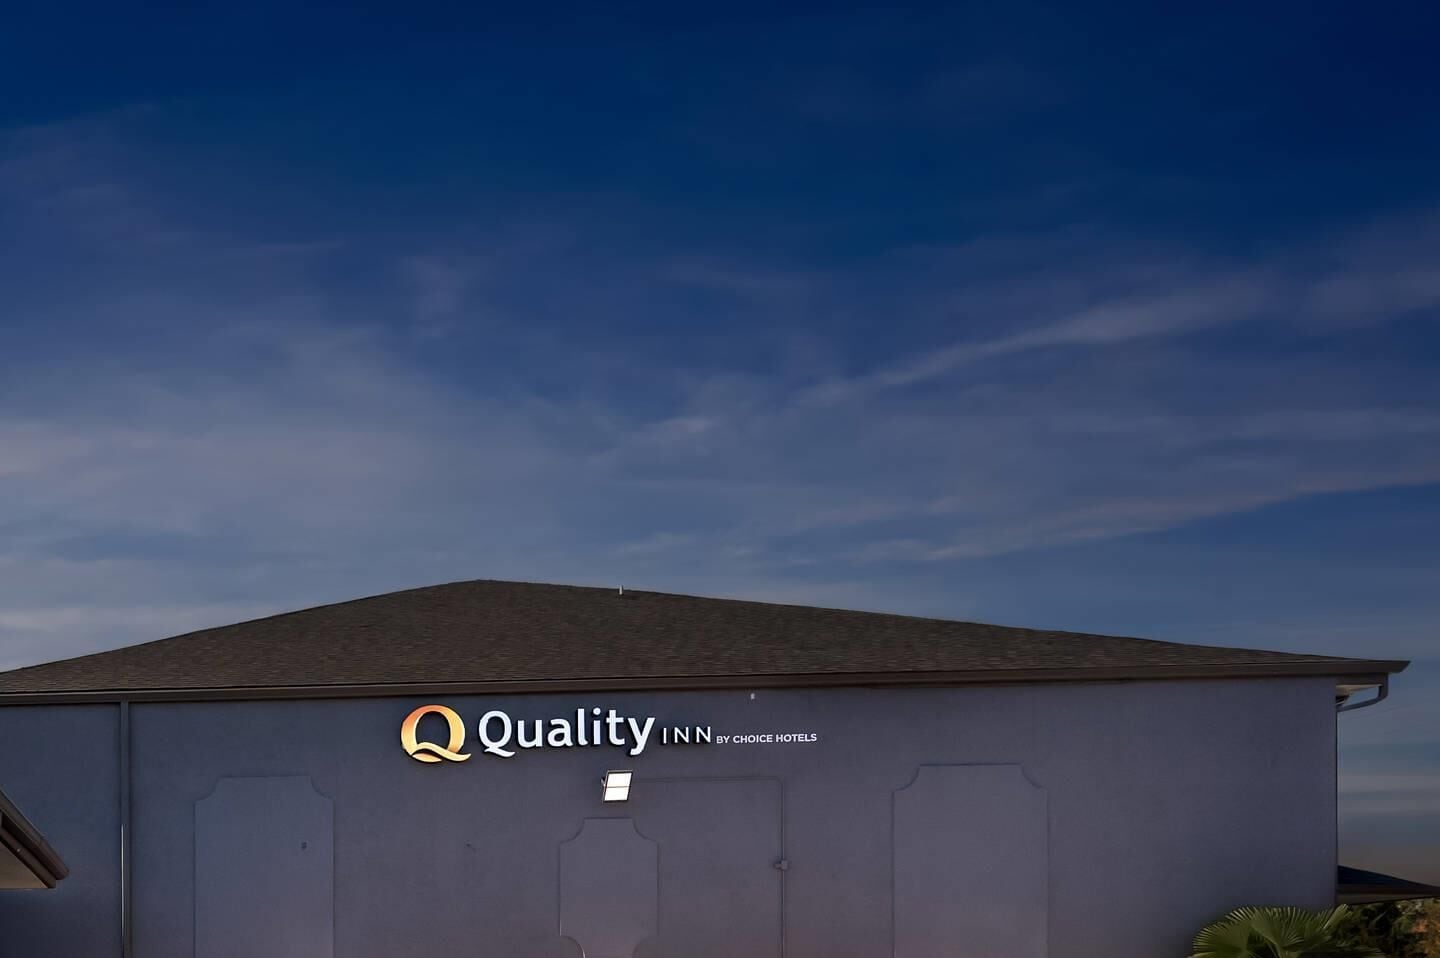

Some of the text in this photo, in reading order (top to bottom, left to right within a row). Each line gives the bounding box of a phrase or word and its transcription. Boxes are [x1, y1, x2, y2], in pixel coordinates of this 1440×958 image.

[478, 707, 818, 757] Quality INN BY CHOICE HOTELS
